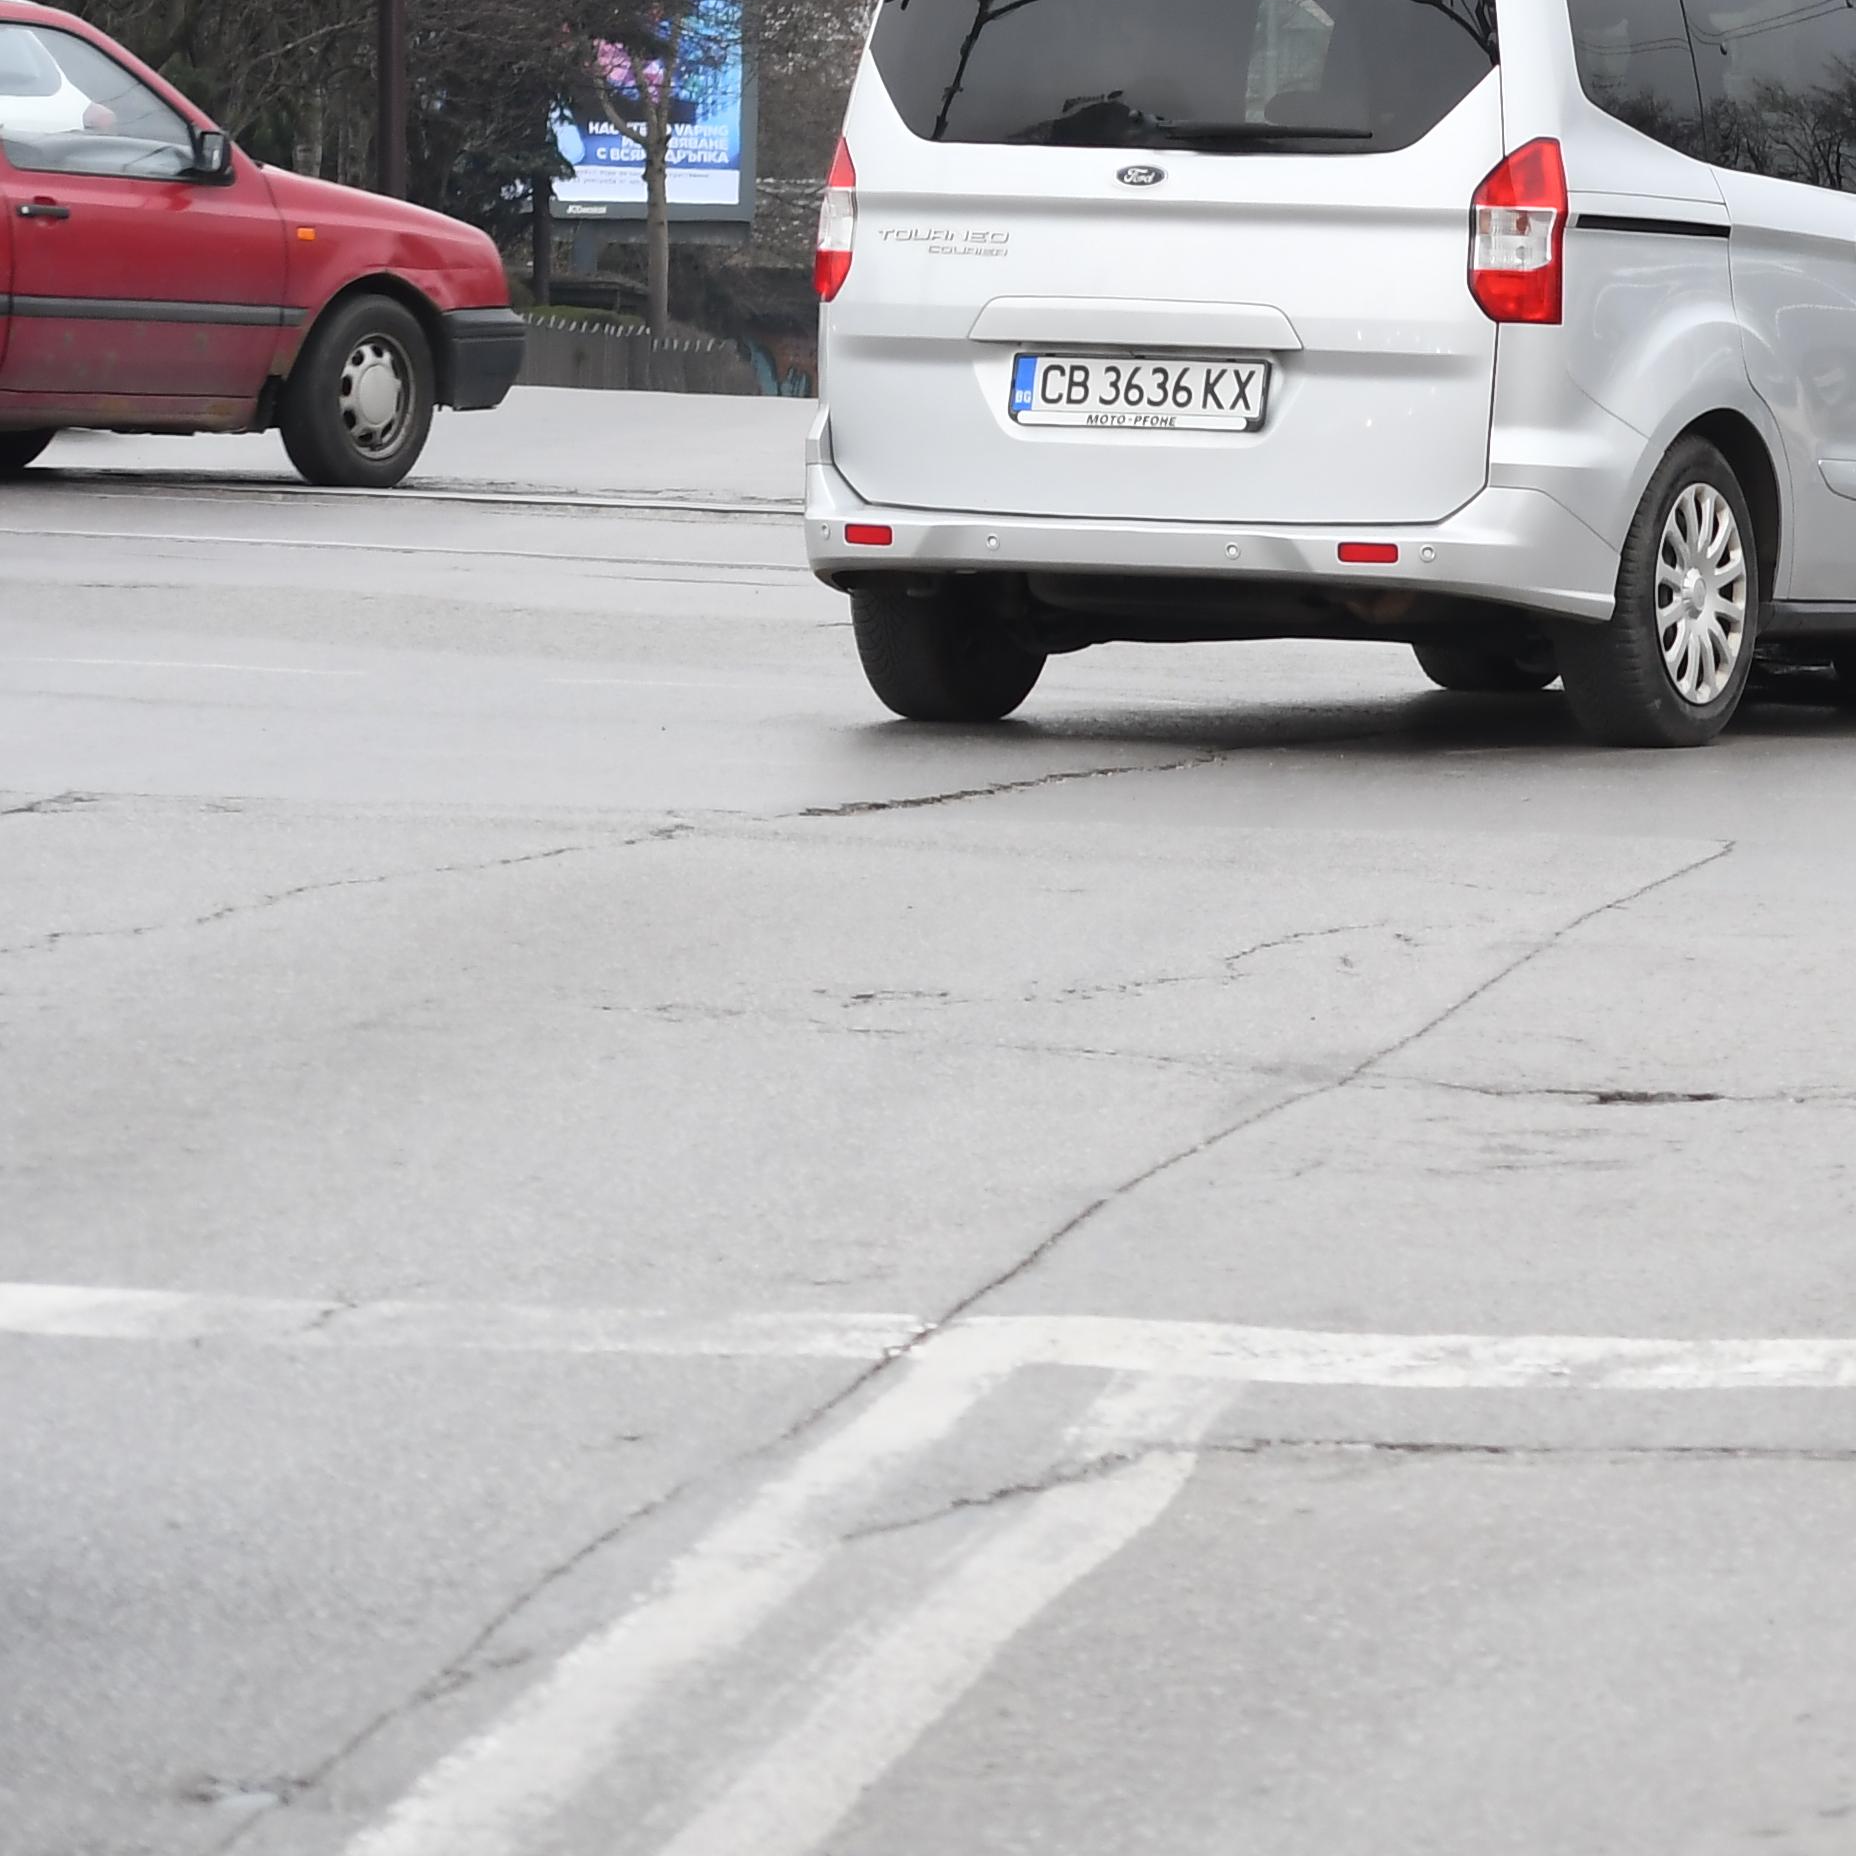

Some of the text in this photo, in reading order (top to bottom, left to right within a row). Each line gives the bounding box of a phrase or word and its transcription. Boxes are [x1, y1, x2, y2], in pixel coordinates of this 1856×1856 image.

[674, 124, 728, 137] VAPING
[1123, 168, 1157, 184] Ford
[878, 229, 1010, 244] TOURNEO
[1041, 364, 1256, 411] CB 3636 KX
[1015, 390, 1031, 403] BG
